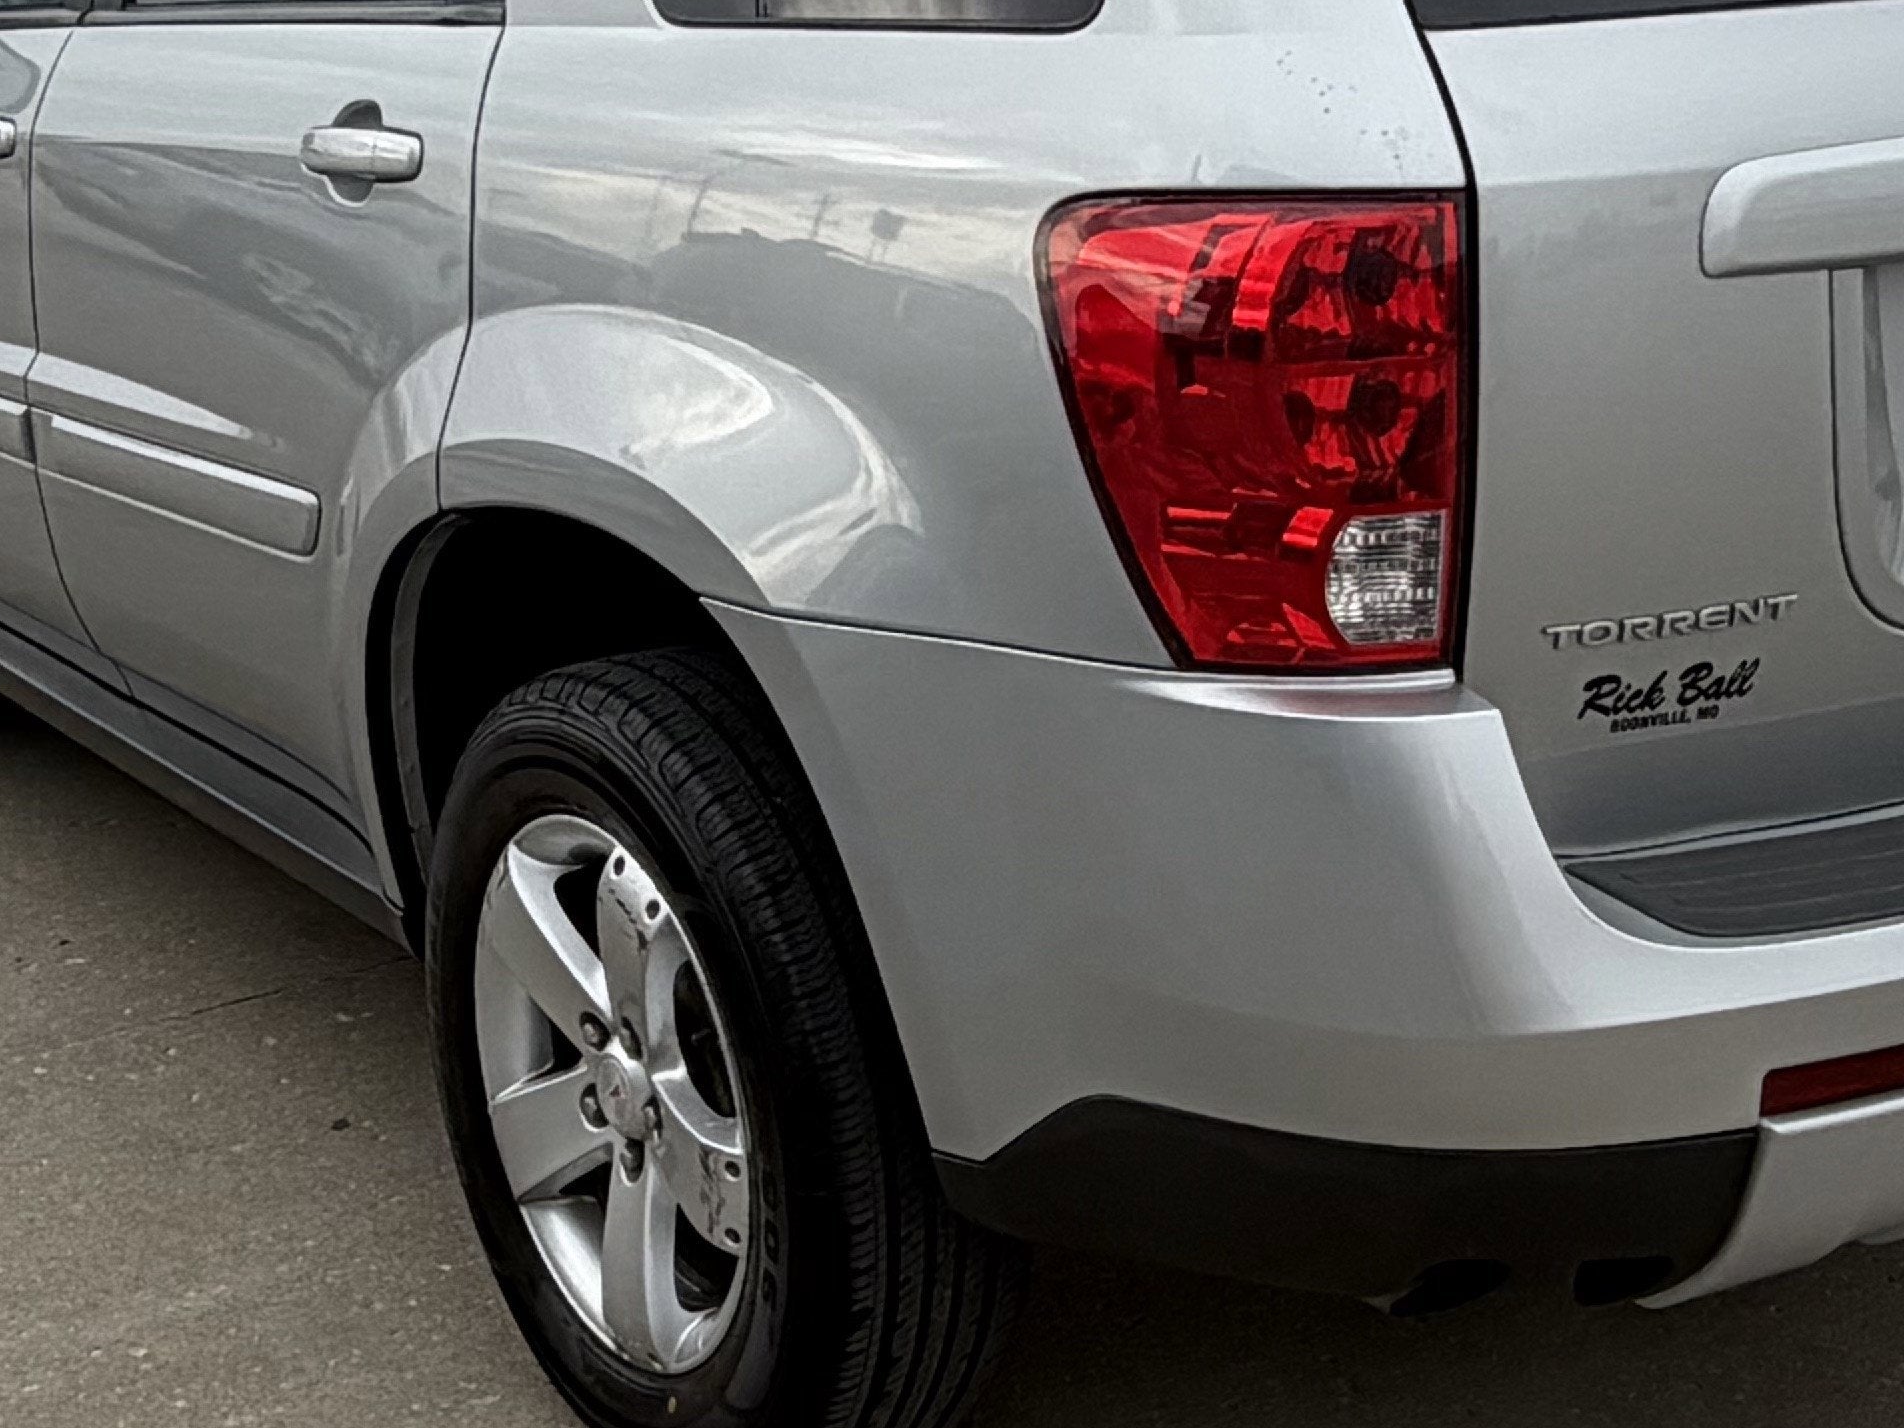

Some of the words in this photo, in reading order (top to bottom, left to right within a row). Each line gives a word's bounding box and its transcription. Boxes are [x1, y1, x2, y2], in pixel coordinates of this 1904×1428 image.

[1542, 591, 1799, 650] TORRENT
[1577, 671, 1667, 720] Rick
[1677, 657, 1760, 707] Ball
